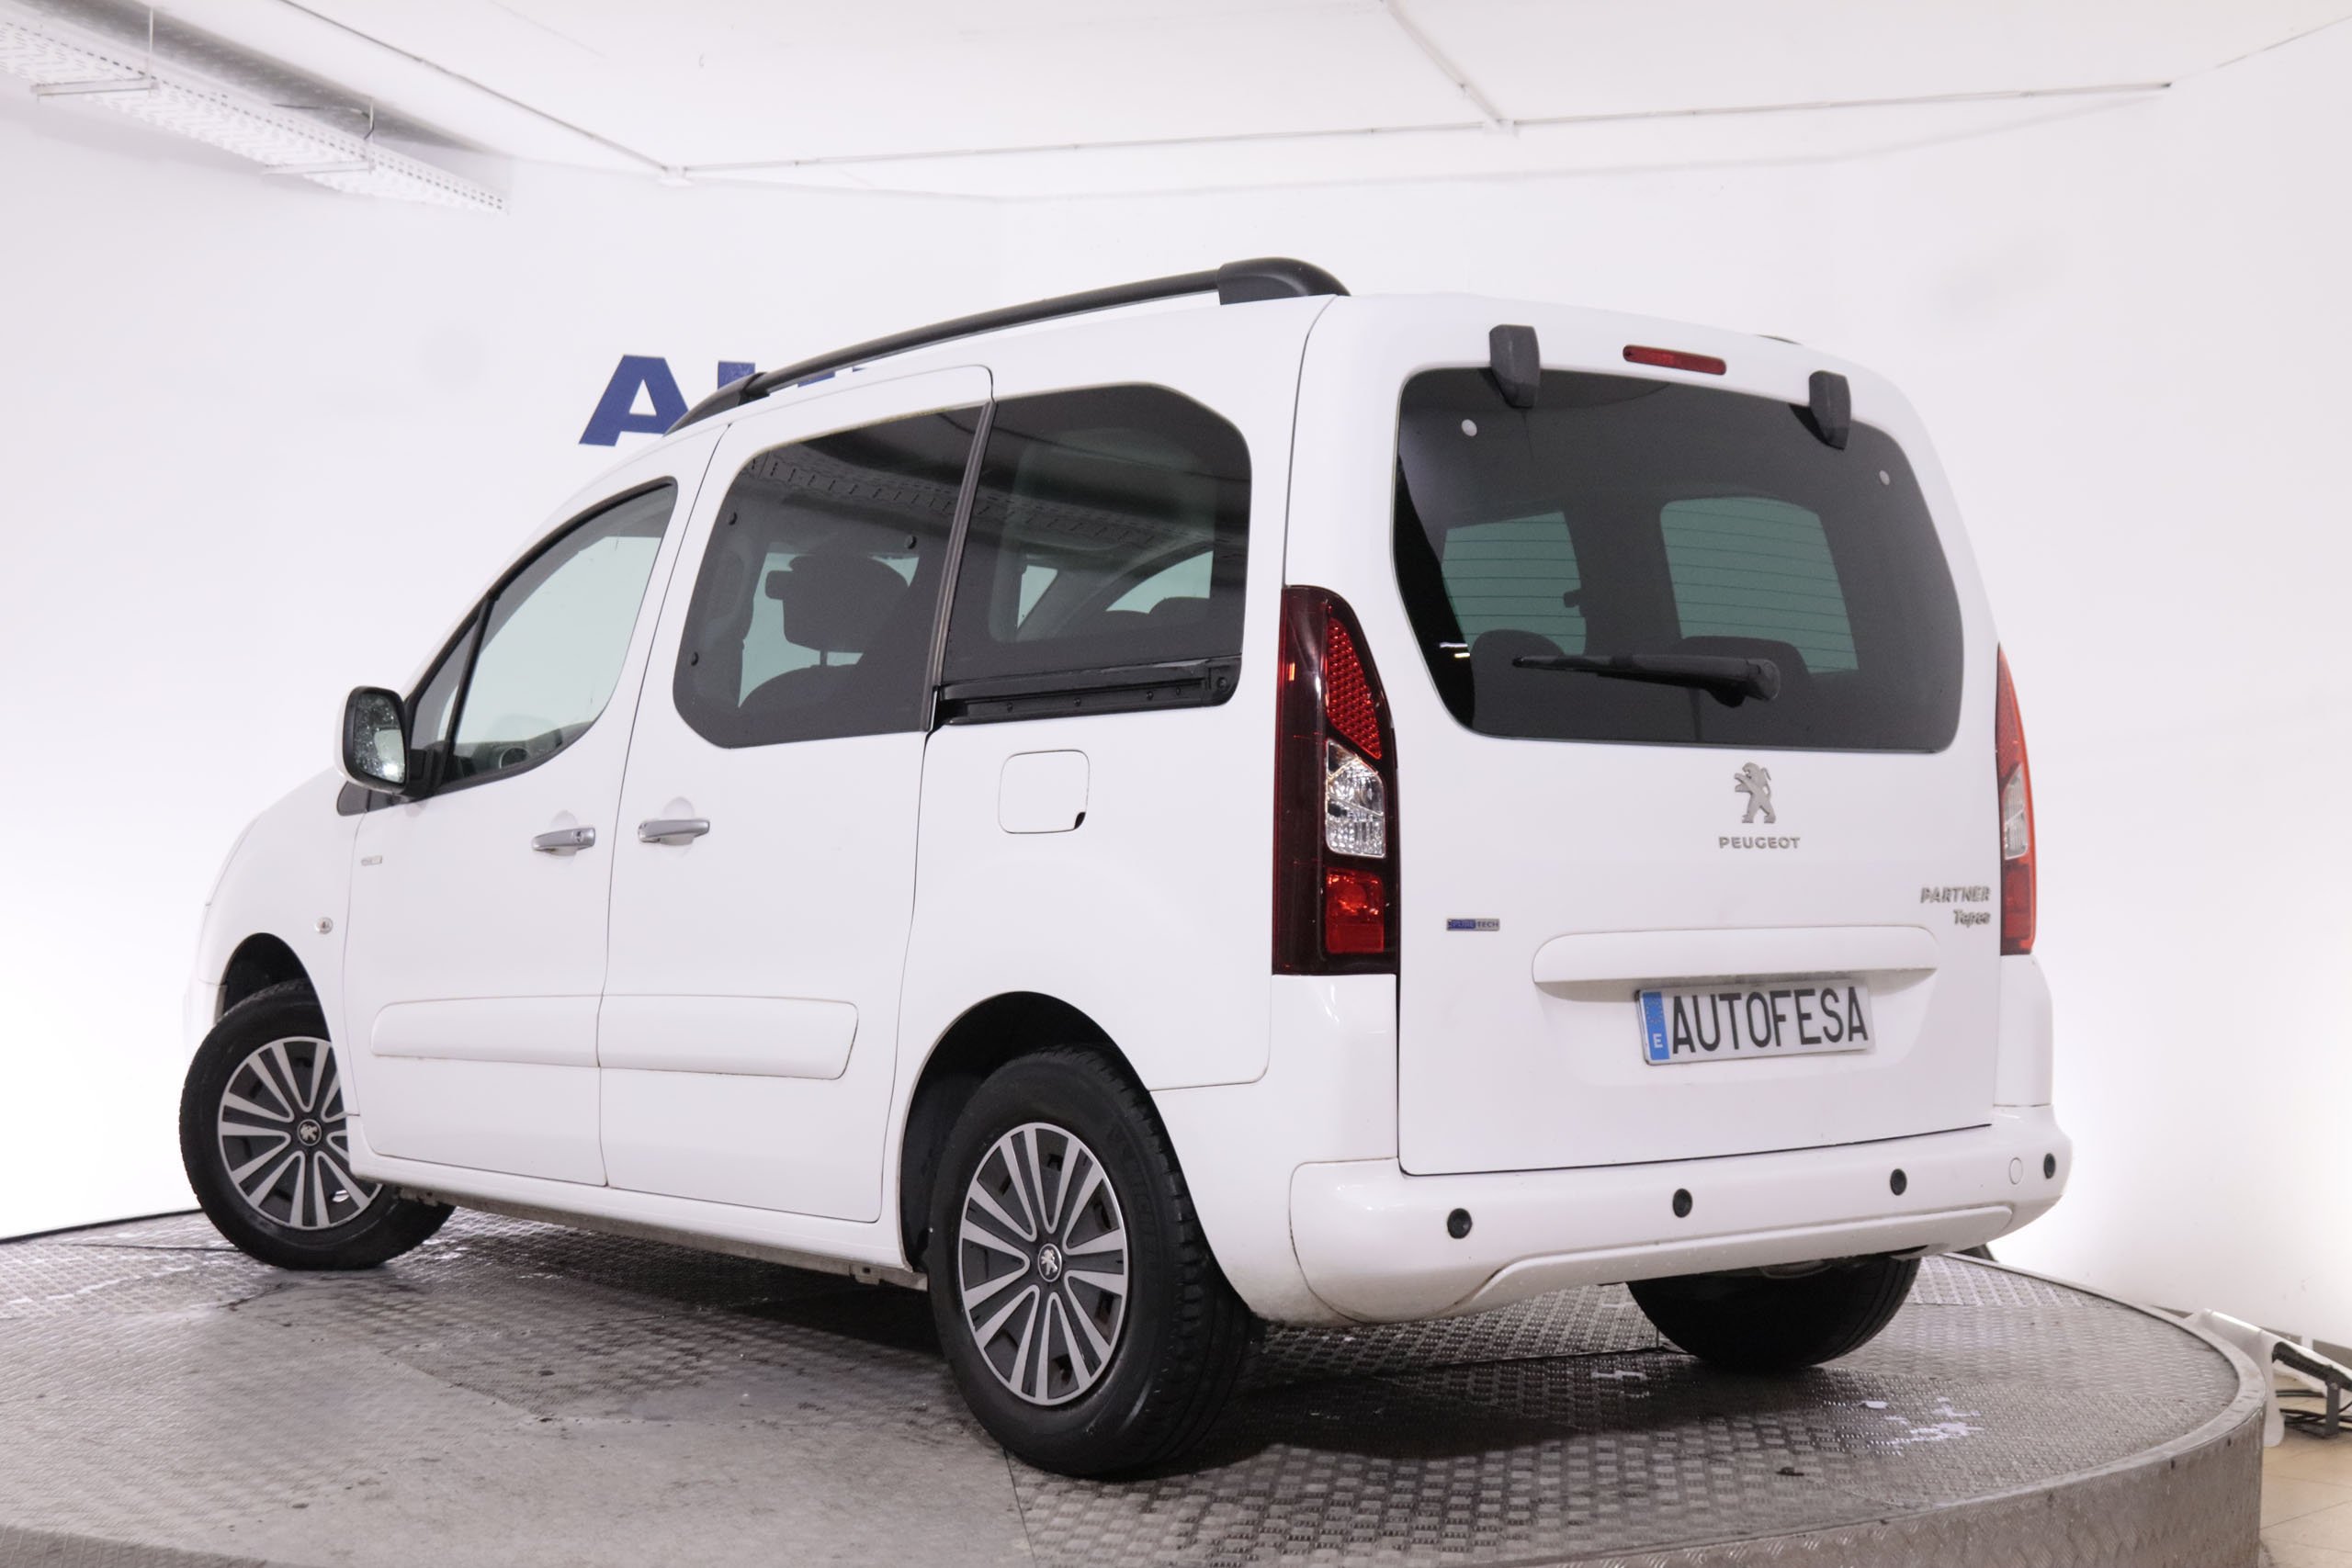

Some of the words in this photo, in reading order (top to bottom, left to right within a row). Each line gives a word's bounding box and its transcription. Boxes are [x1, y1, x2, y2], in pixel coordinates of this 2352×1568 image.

[1719, 837, 1801, 849] PEUGEOT
[1920, 886, 1991, 903] PARTNER
[1673, 987, 1869, 1054] AUTOFESA
[1653, 1033, 1663, 1048] E
